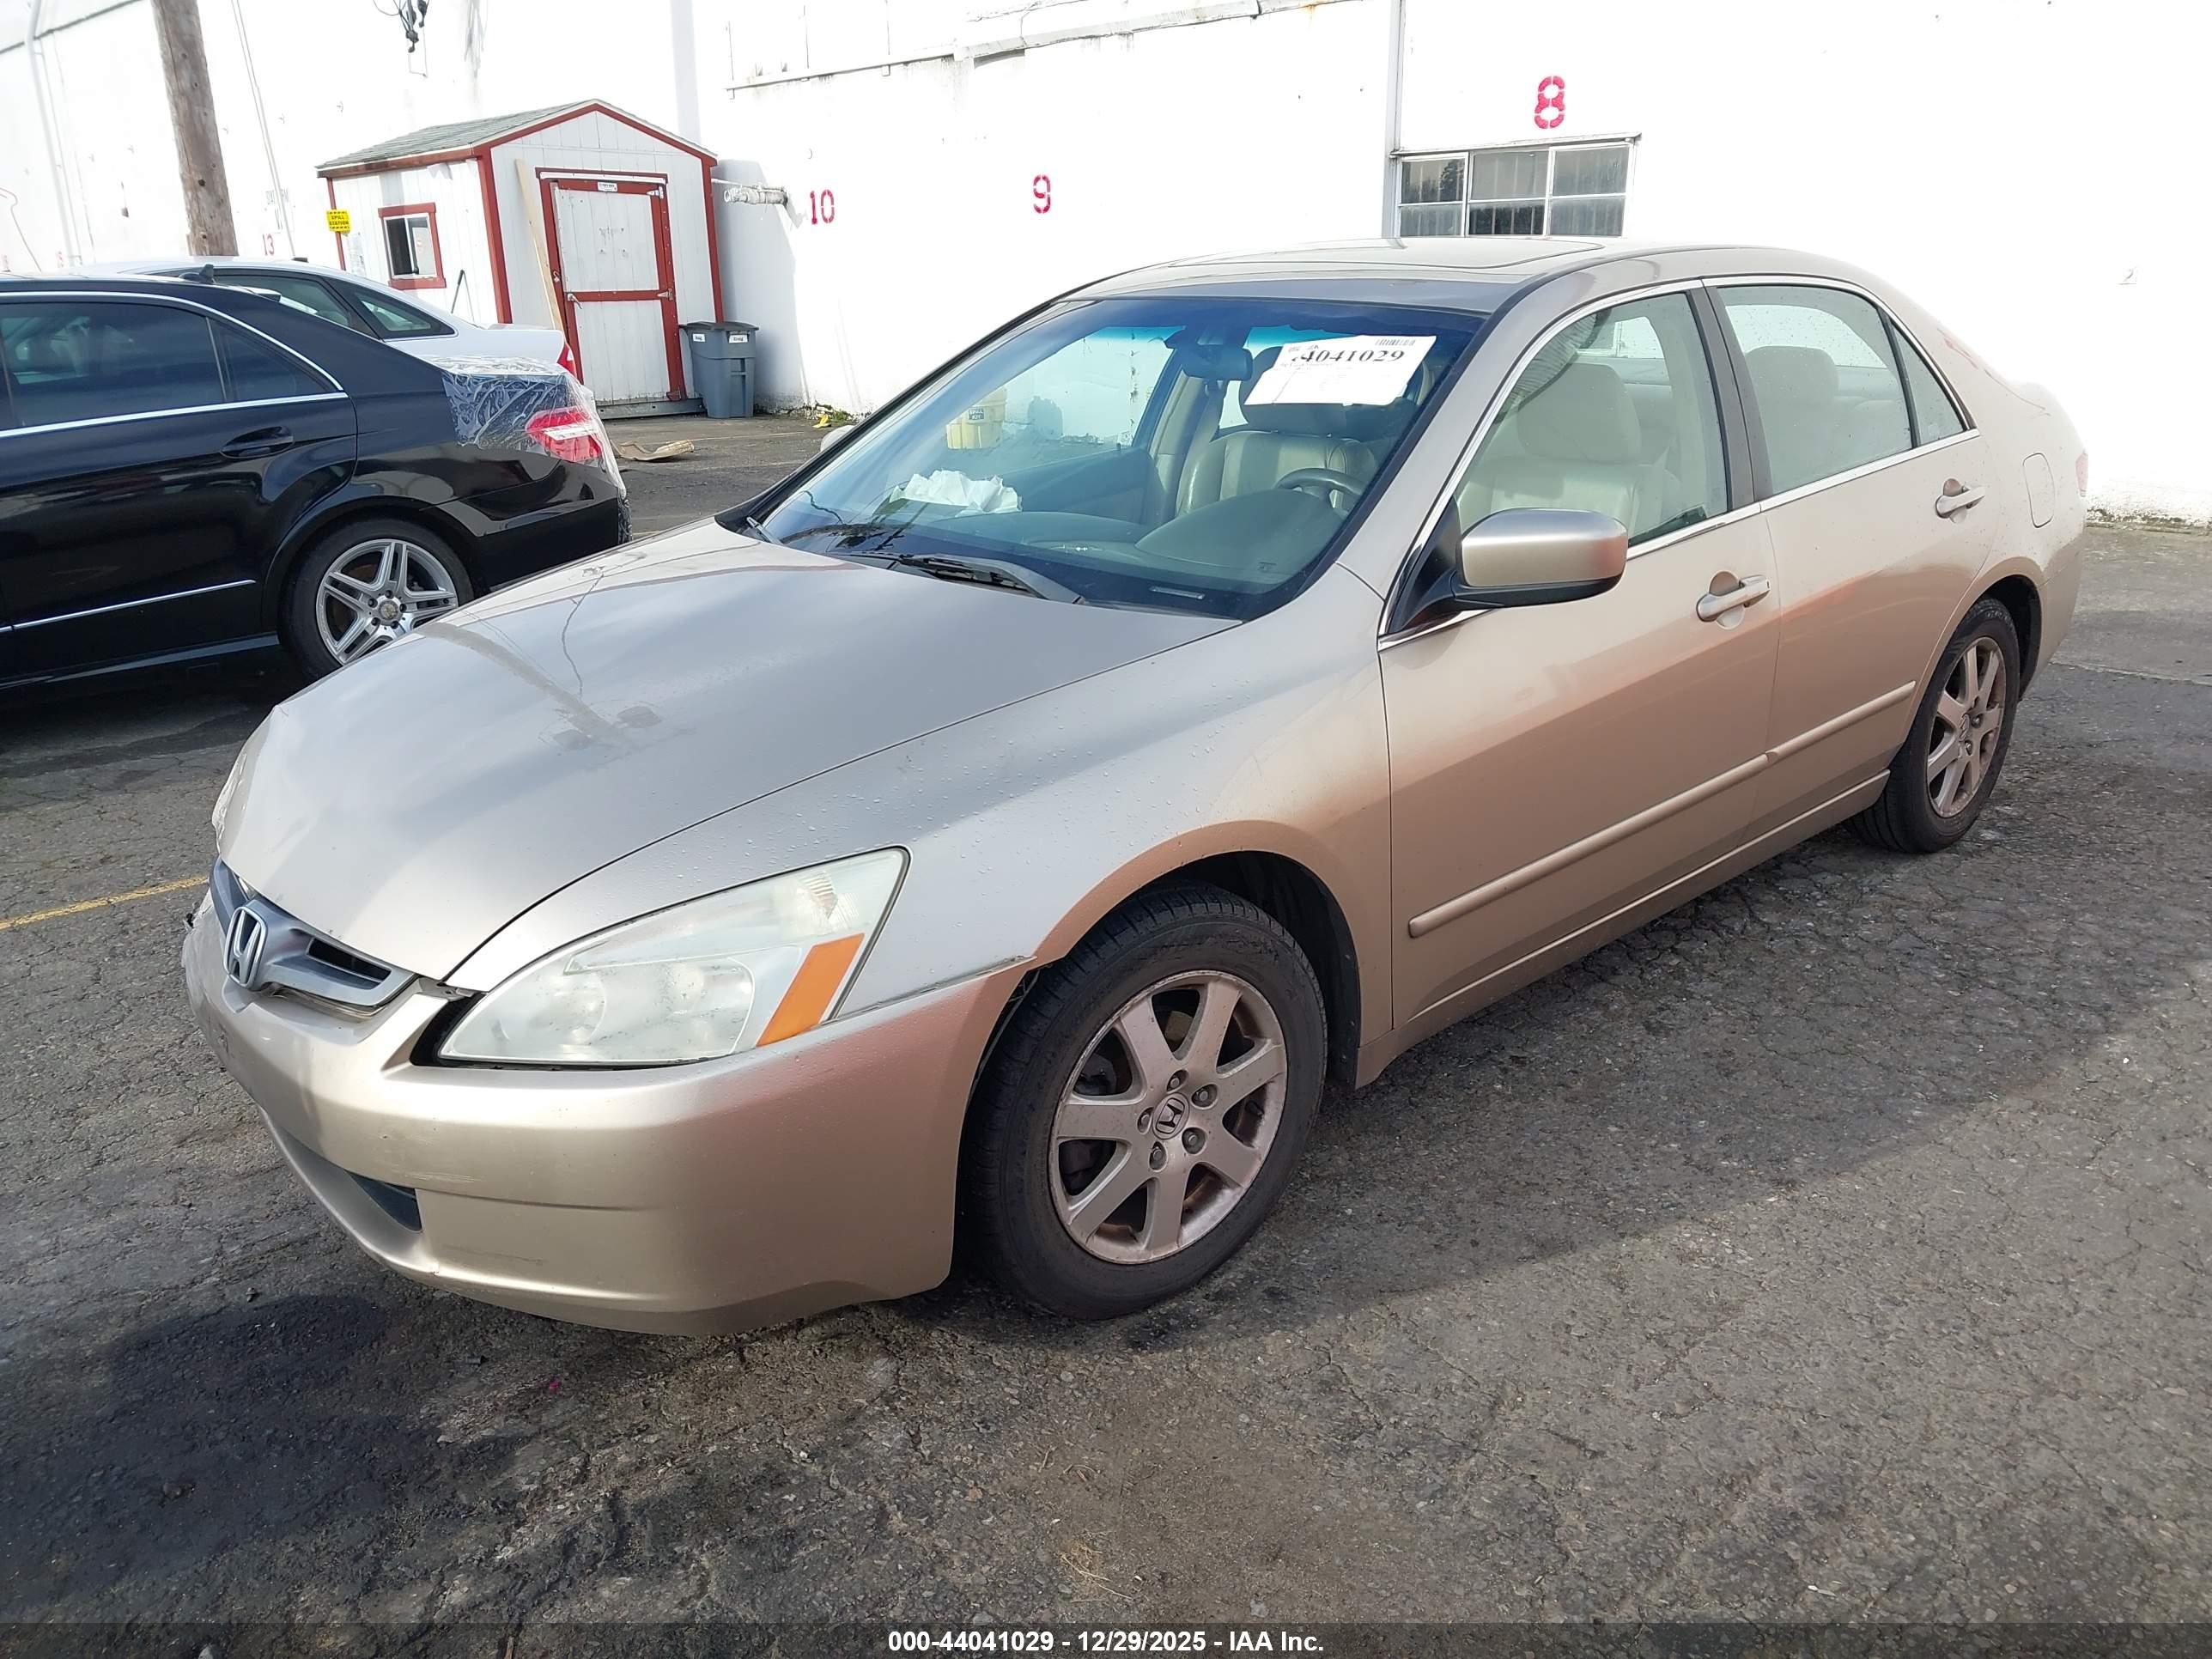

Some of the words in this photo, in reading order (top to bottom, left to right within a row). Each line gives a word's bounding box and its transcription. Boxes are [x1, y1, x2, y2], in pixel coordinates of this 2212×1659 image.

[1534, 76, 1565, 129] 8
[810, 189, 836, 225] 10
[1033, 174, 1051, 214] 9
[262, 233, 275, 256] 13
